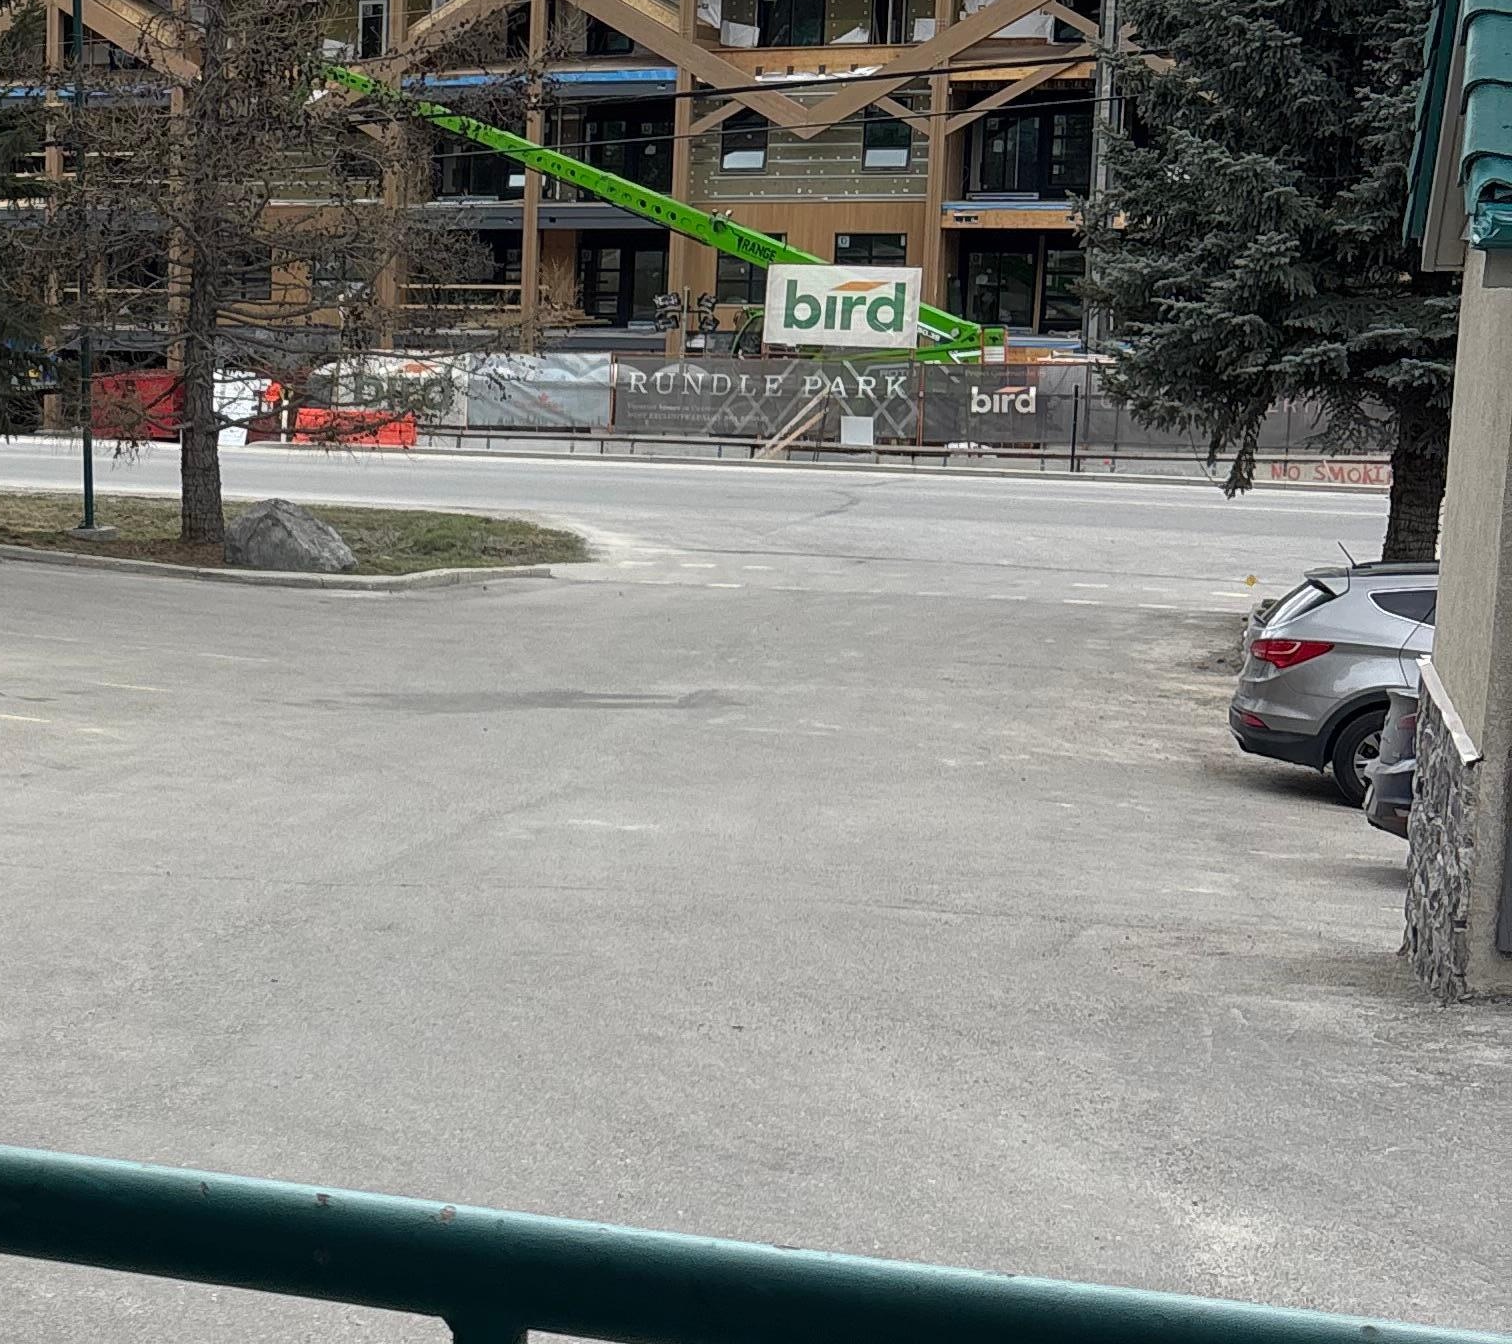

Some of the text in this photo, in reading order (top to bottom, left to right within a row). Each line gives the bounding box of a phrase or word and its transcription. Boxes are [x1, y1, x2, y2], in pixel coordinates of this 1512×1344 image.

[783, 279, 907, 333] bird
[627, 371, 908, 399] RUNDLE PARK
[970, 386, 1037, 414] bird
[1270, 463, 1301, 481] NO
